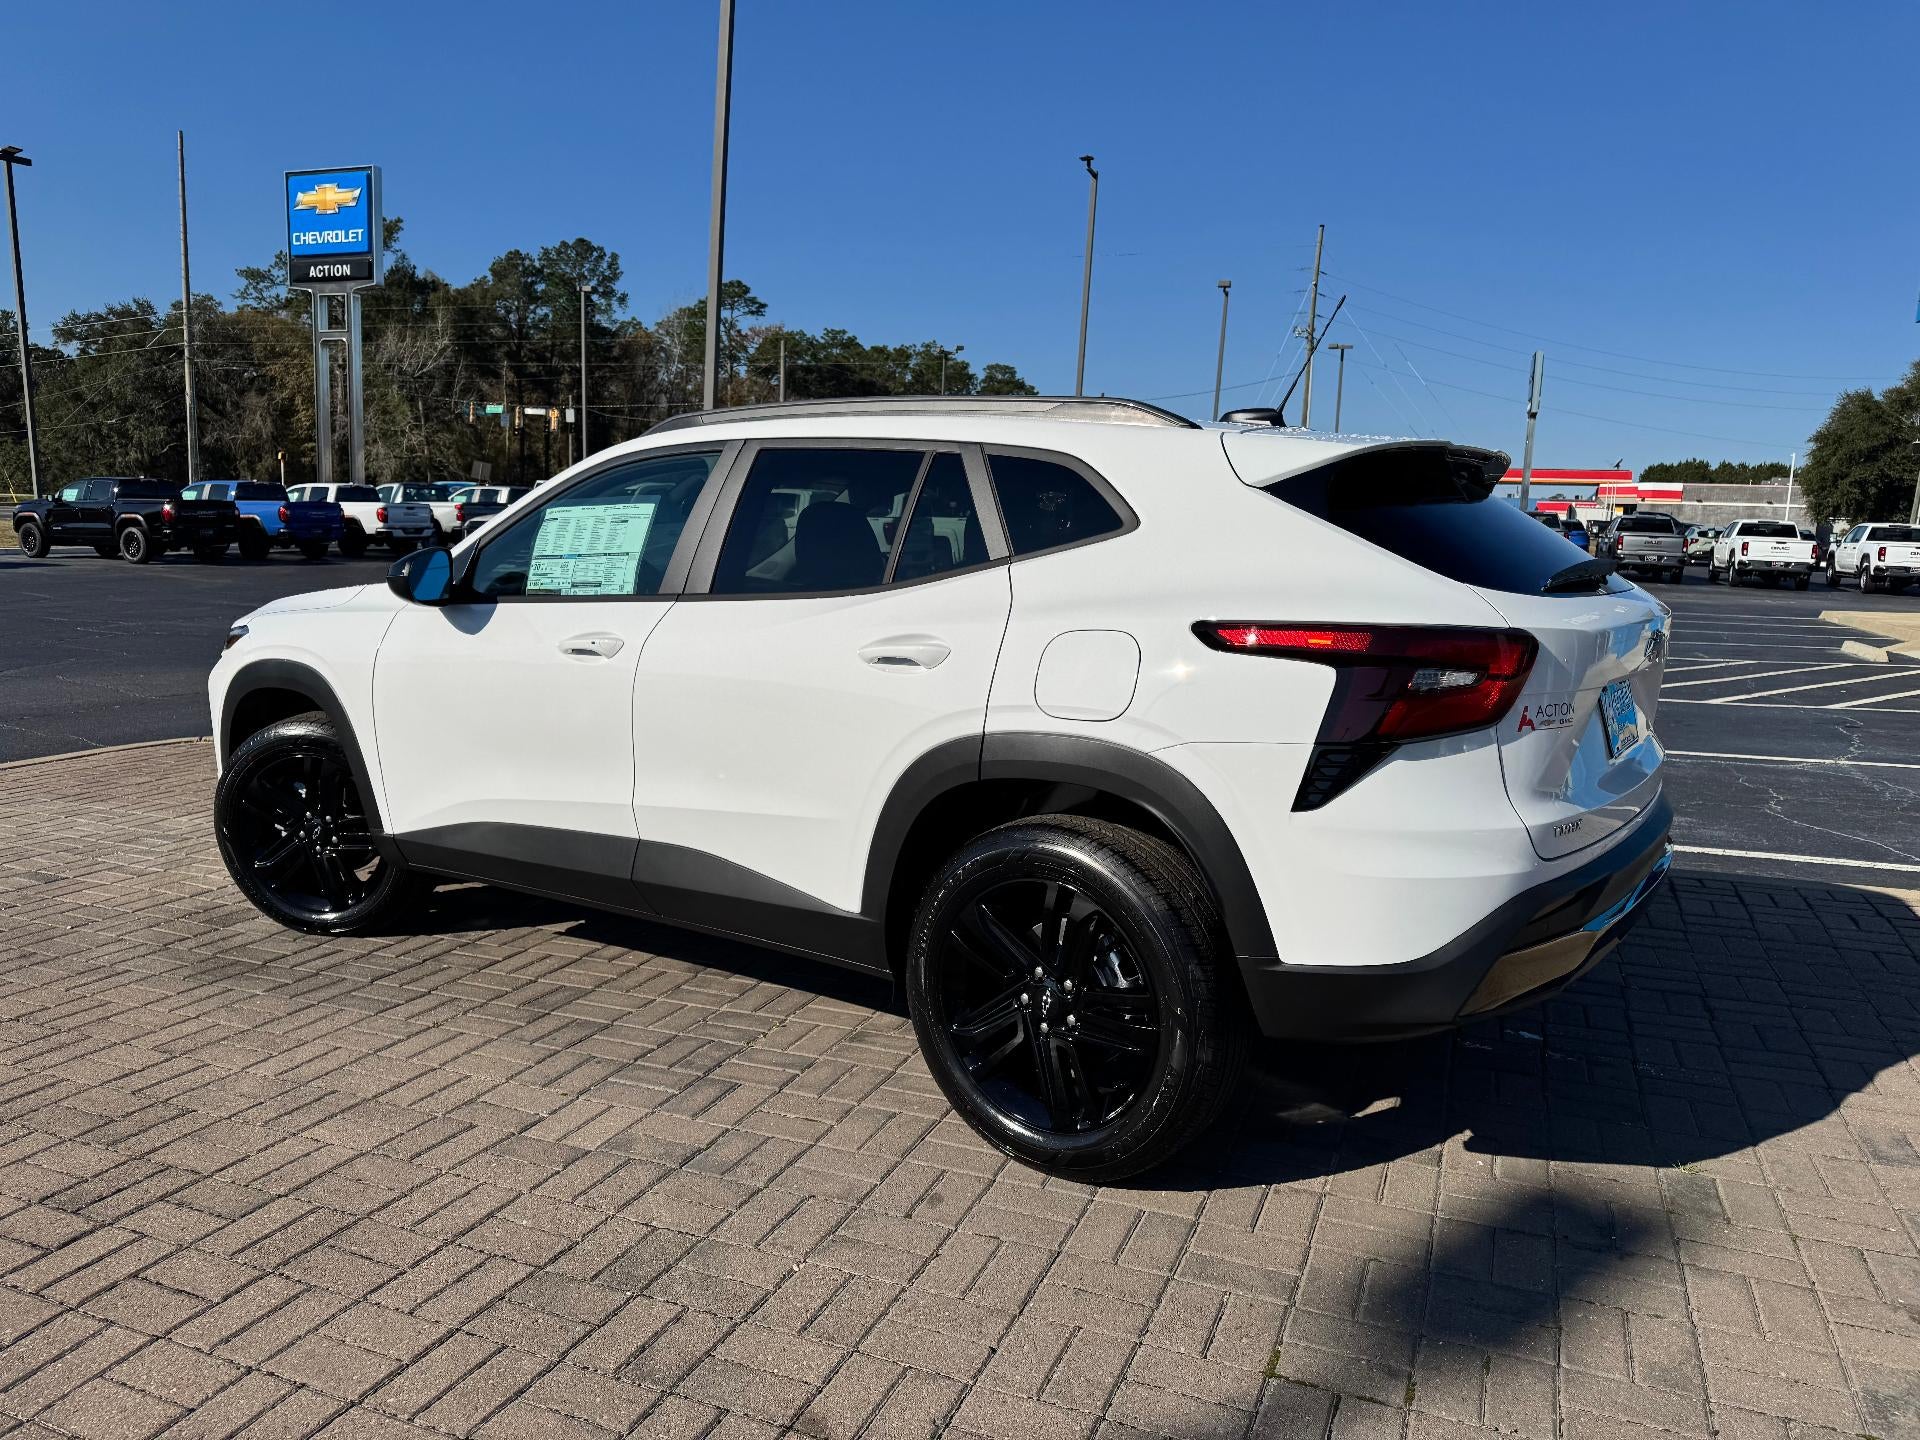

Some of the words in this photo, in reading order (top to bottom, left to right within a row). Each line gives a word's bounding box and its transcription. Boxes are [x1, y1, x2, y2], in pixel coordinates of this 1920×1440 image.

[292, 229, 364, 245] CHEVROLET
[309, 264, 351, 278] ACTION
[1535, 702, 1575, 719] ACTION
